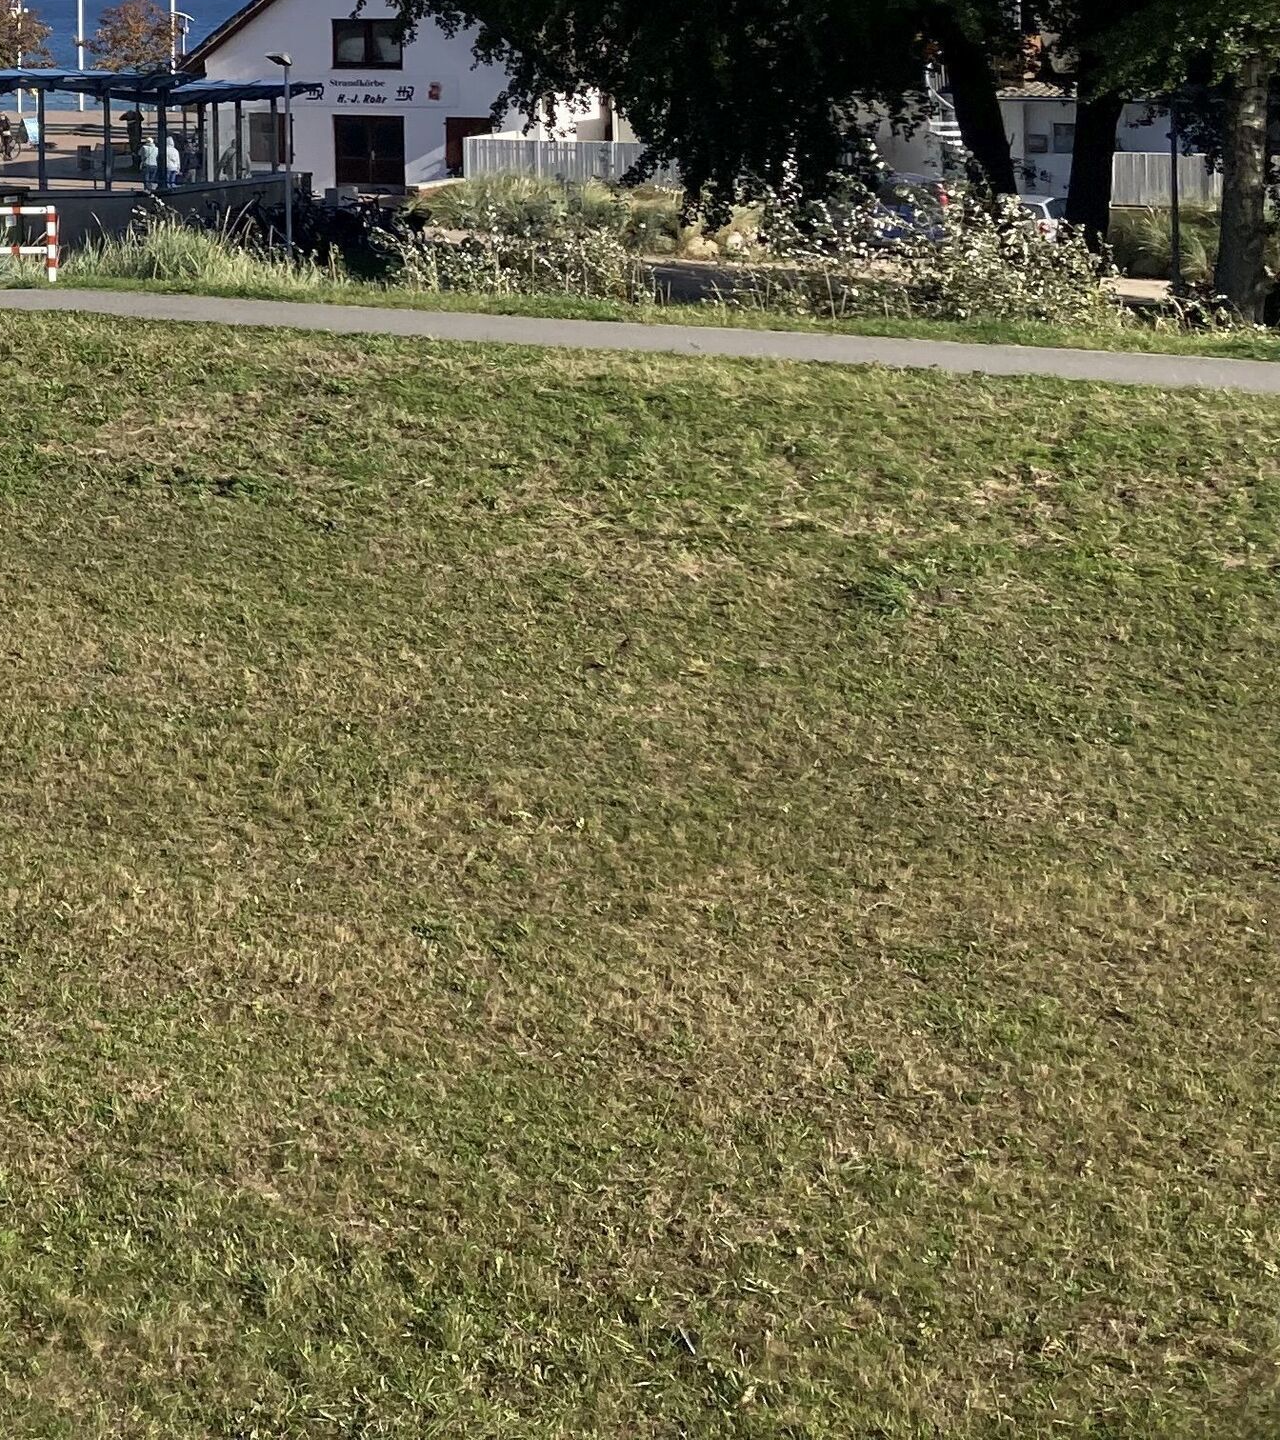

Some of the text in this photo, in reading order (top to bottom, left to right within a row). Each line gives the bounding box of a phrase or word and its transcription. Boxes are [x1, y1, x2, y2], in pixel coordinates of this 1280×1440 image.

[329, 78, 386, 87] Strandkörbe
[337, 93, 388, 104] H.-J. Rohr
